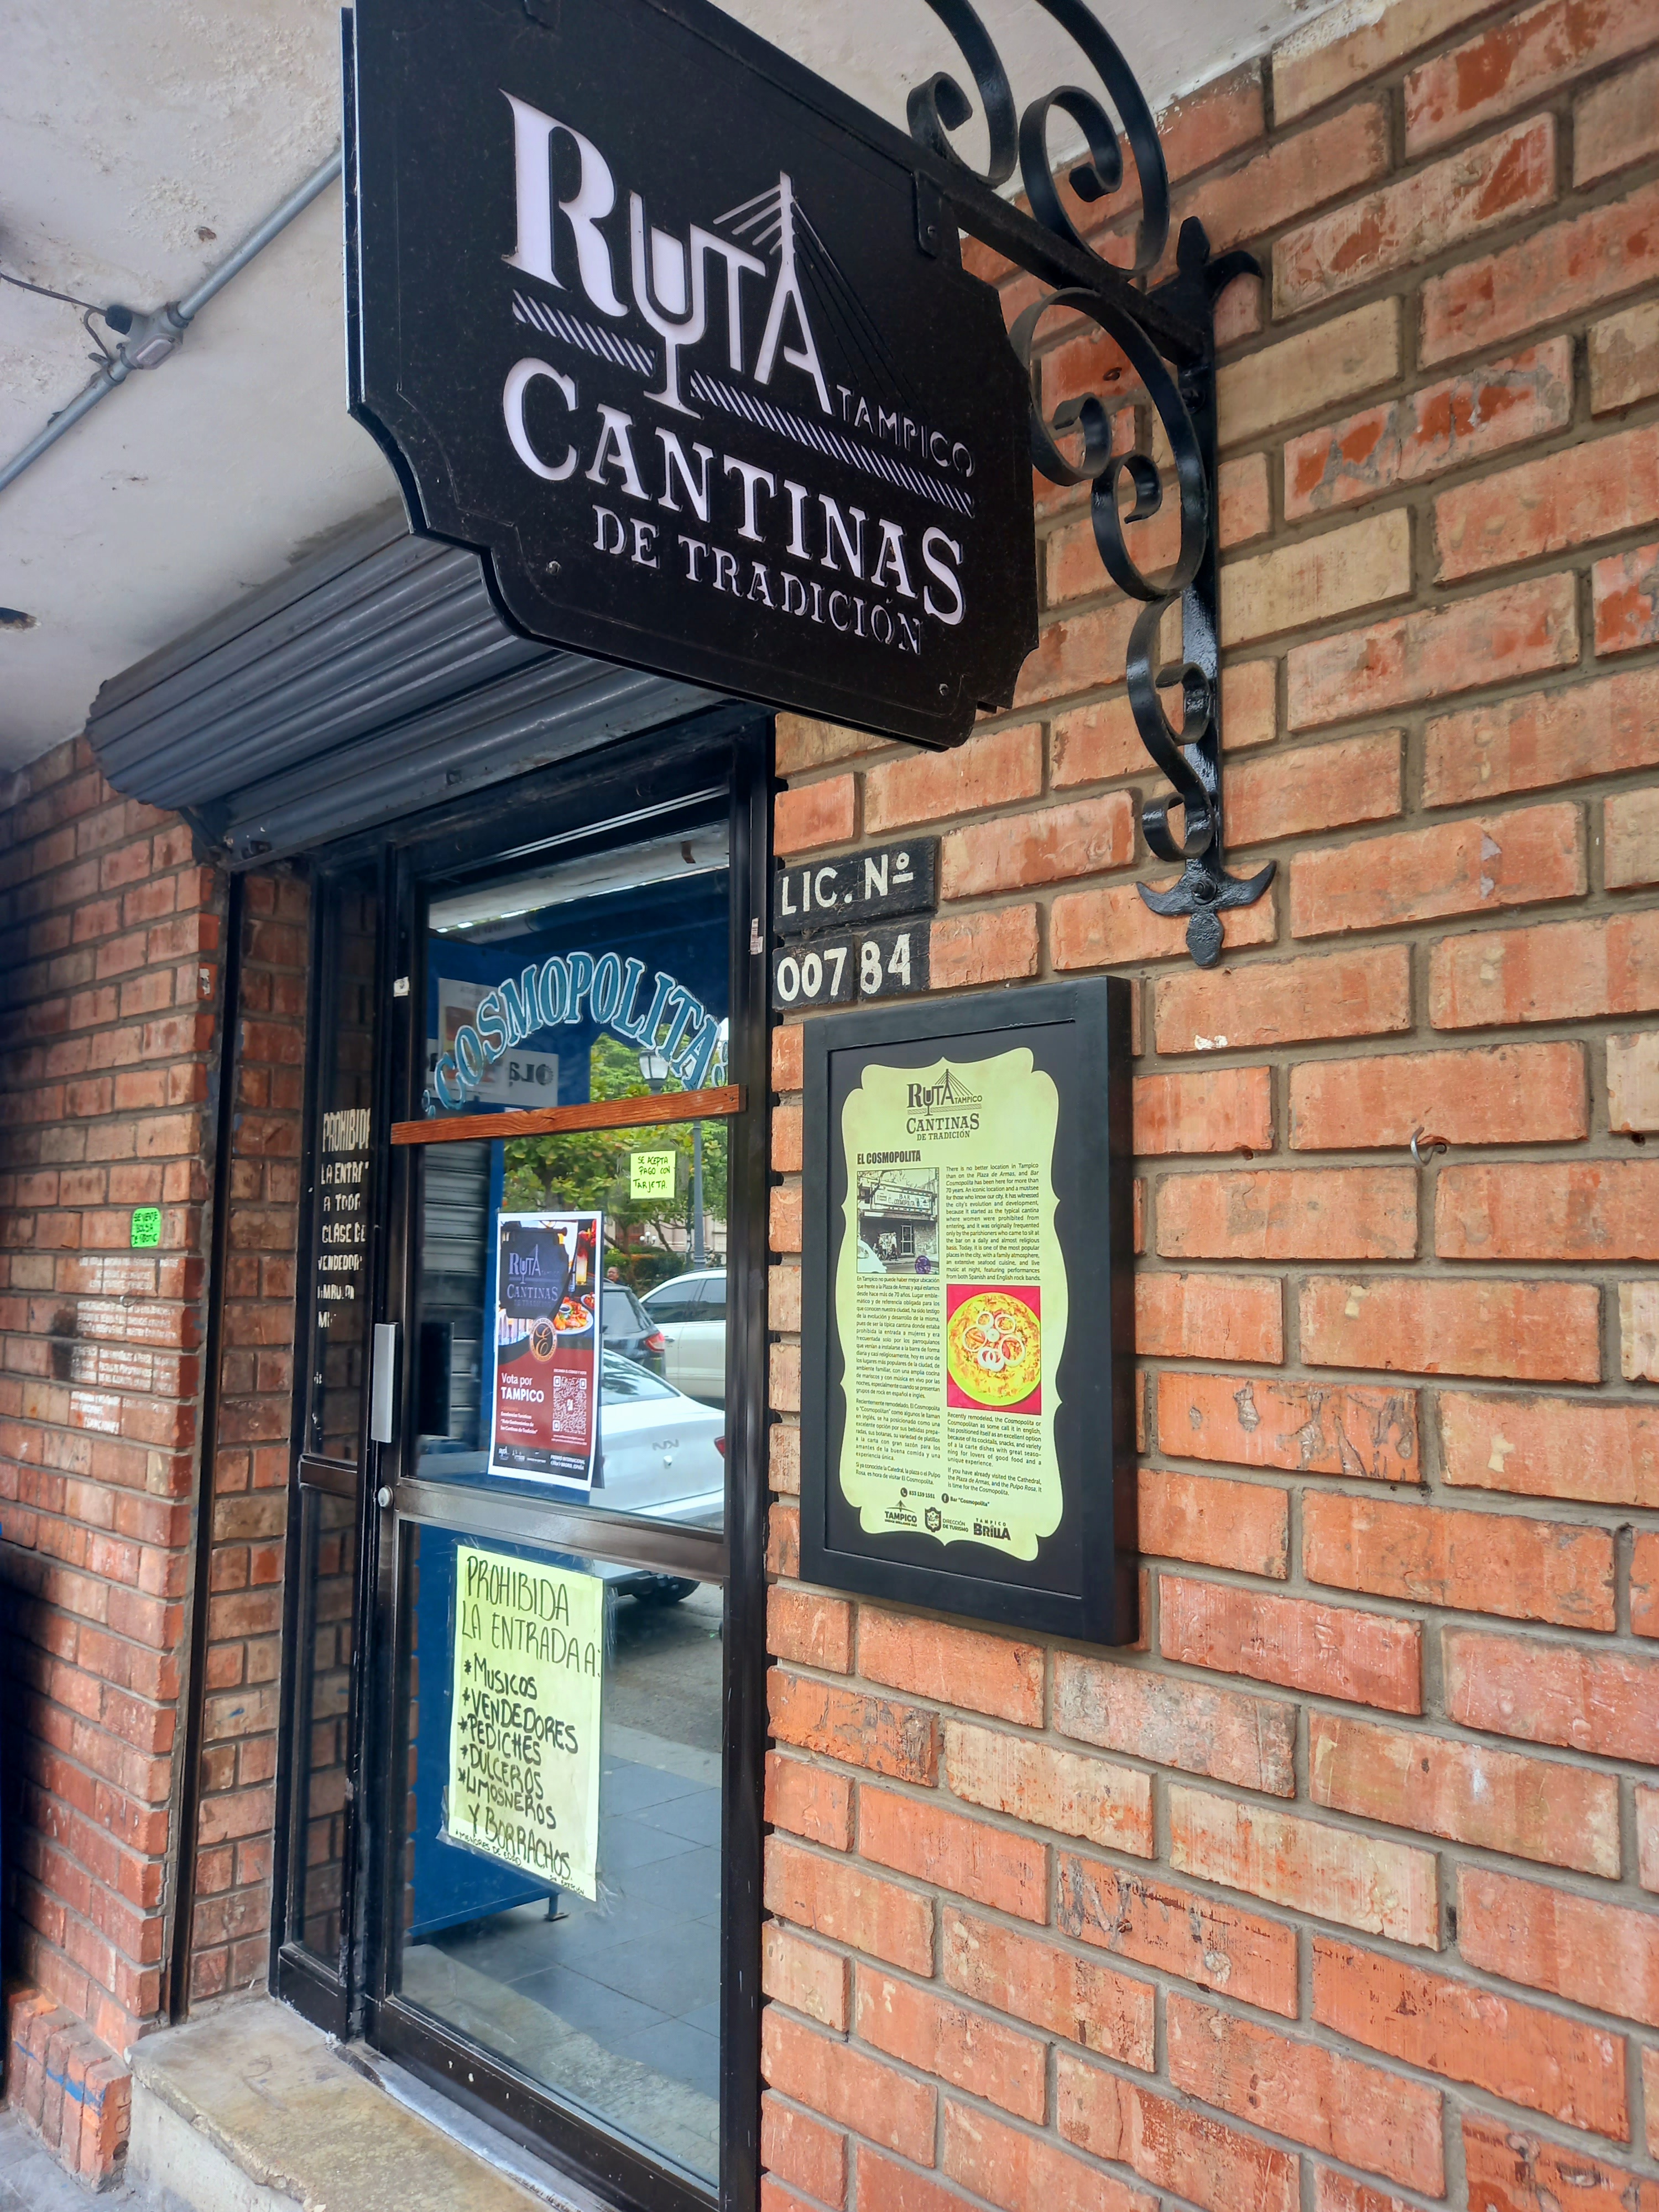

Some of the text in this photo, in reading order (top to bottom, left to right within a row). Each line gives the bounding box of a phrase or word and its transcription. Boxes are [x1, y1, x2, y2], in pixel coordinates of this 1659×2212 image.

[499, 87, 834, 419] RUTA
[837, 384, 975, 478] TAMPICO
[503, 357, 965, 625] CANTINAS
[593, 504, 923, 655] DE TRADICIÓN
[781, 867, 852, 915] LIC.
[435, 951, 722, 1110] COSMOPOLITA
[906, 1068, 954, 1117] RUTA
[954, 1095, 983, 1104] TAMPICO
[906, 1113, 979, 1134] CANTINAS
[928, 1129, 971, 1140] TRADICIÓN
[638, 1156, 668, 1166] SE ACEPTA
[639, 1166, 670, 1175] PAGO CON
[857, 1150, 921, 1165] EL COSMOPOLITA
[321, 1164, 333, 1185] LA
[322, 1223, 352, 1243] CLASE
[507, 1284, 558, 1301] CANTINAS
[501, 1373, 533, 1387] Vota por
[500, 1386, 544, 1403] TAMPICO
[884, 1511, 917, 1523] TAMPICO
[942, 1518, 966, 1526] DIRECCIÓN
[975, 1518, 1006, 1527] TAMPICO
[467, 1556, 569, 1626] PROHIBIDA
[462, 1600, 481, 1640] LA
[492, 1612, 580, 1673] ENTRADA
[474, 1652, 538, 1700] MUSICOS
[471, 1688, 578, 1754] VENDEDORES
[467, 1713, 541, 1766] PEDICHES
[469, 1743, 544, 1800] DULCEROS
[466, 1766, 556, 1829] LIMOSNEROS
[468, 1803, 480, 1837] Y
[492, 1846, 501, 1855] DE
